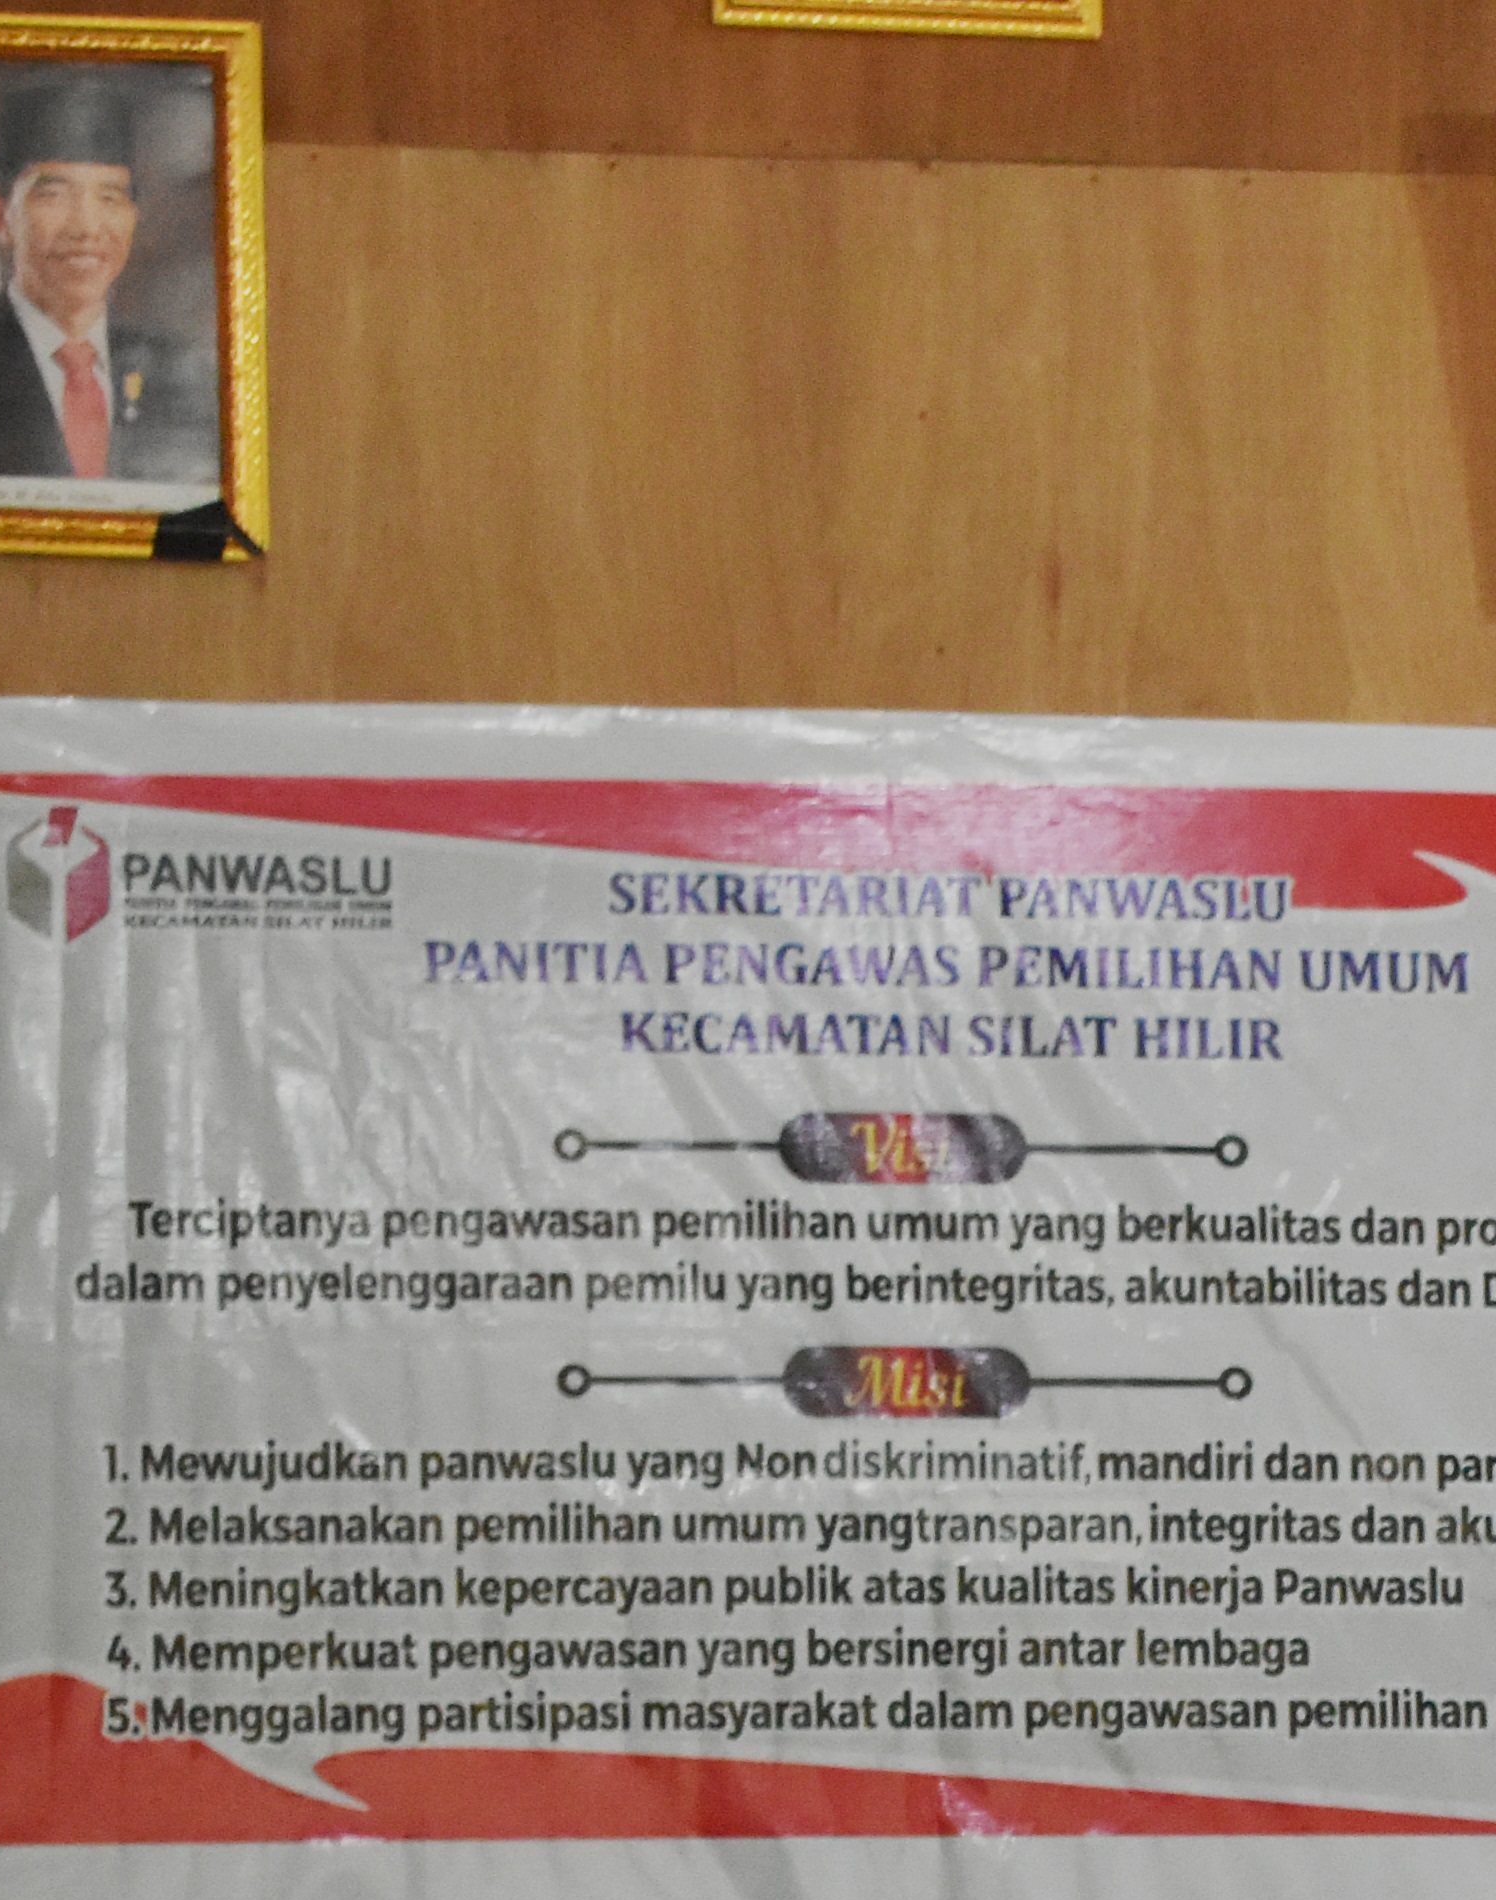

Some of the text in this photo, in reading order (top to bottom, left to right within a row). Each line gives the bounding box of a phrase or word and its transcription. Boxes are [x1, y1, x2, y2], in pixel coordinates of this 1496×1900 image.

[122, 853, 393, 896] PANWASLU
[608, 872, 1288, 923] SEKRETARIAT PANWASLU
[422, 938, 1469, 995] PANITIA PENGAWAS PEMILIHAN UMUM
[618, 1009, 1284, 1062] KECAMATAN SILAT HILIR
[126, 1198, 372, 1250] Terciptanya
[381, 1206, 642, 1250] pengawasan
[651, 1201, 858, 1250] pemilihan
[866, 1209, 1001, 1244] umum
[1008, 1210, 1107, 1252] yang
[1117, 1204, 1342, 1246] berkualitas
[1349, 1205, 1427, 1247] dan
[73, 1261, 206, 1304] dalam
[216, 1261, 575, 1313] penyelenggaraan
[584, 1262, 728, 1313] pemilu
[735, 1270, 836, 1314] yang
[844, 1263, 1116, 1314] berintegritas,
[1123, 1264, 1389, 1308] akuntabilitas
[1395, 1266, 1473, 1309] dan
[843, 1355, 967, 1408] Misi
[102, 1442, 131, 1484] 1.
[139, 1437, 409, 1490] Mewujudkan
[418, 1439, 617, 1490] panwaslu
[625, 1449, 726, 1490] yang
[735, 1441, 818, 1481] Non
[1096, 1439, 1255, 1483] mandiri
[1262, 1440, 1340, 1483] dan
[1349, 1451, 1427, 1484] non
[104, 1505, 139, 1547] 2.
[148, 1502, 445, 1547] Melaksanakan
[454, 1500, 663, 1552] pemilihan
[672, 1511, 808, 1544] umum
[1148, 1501, 1343, 1553] integritas
[1349, 1503, 1427, 1545] dan
[104, 1563, 1465, 1616] 3. Meningkatkan kepercayaan publik atas kualitas kinerja Panwaslu
[105, 1625, 1311, 1678] 4. Memperkuat pengawasan yang bersinergi antar lembaga
[108, 1697, 139, 1734] 5.
[150, 1694, 407, 1744] Menggalang
[416, 1688, 633, 1743] partisipasi
[641, 1688, 879, 1741] masyarakat
[886, 1688, 1015, 1732] dalam
[1023, 1698, 1278, 1740] pengawasan
[1287, 1688, 1489, 1739] pemilihan
